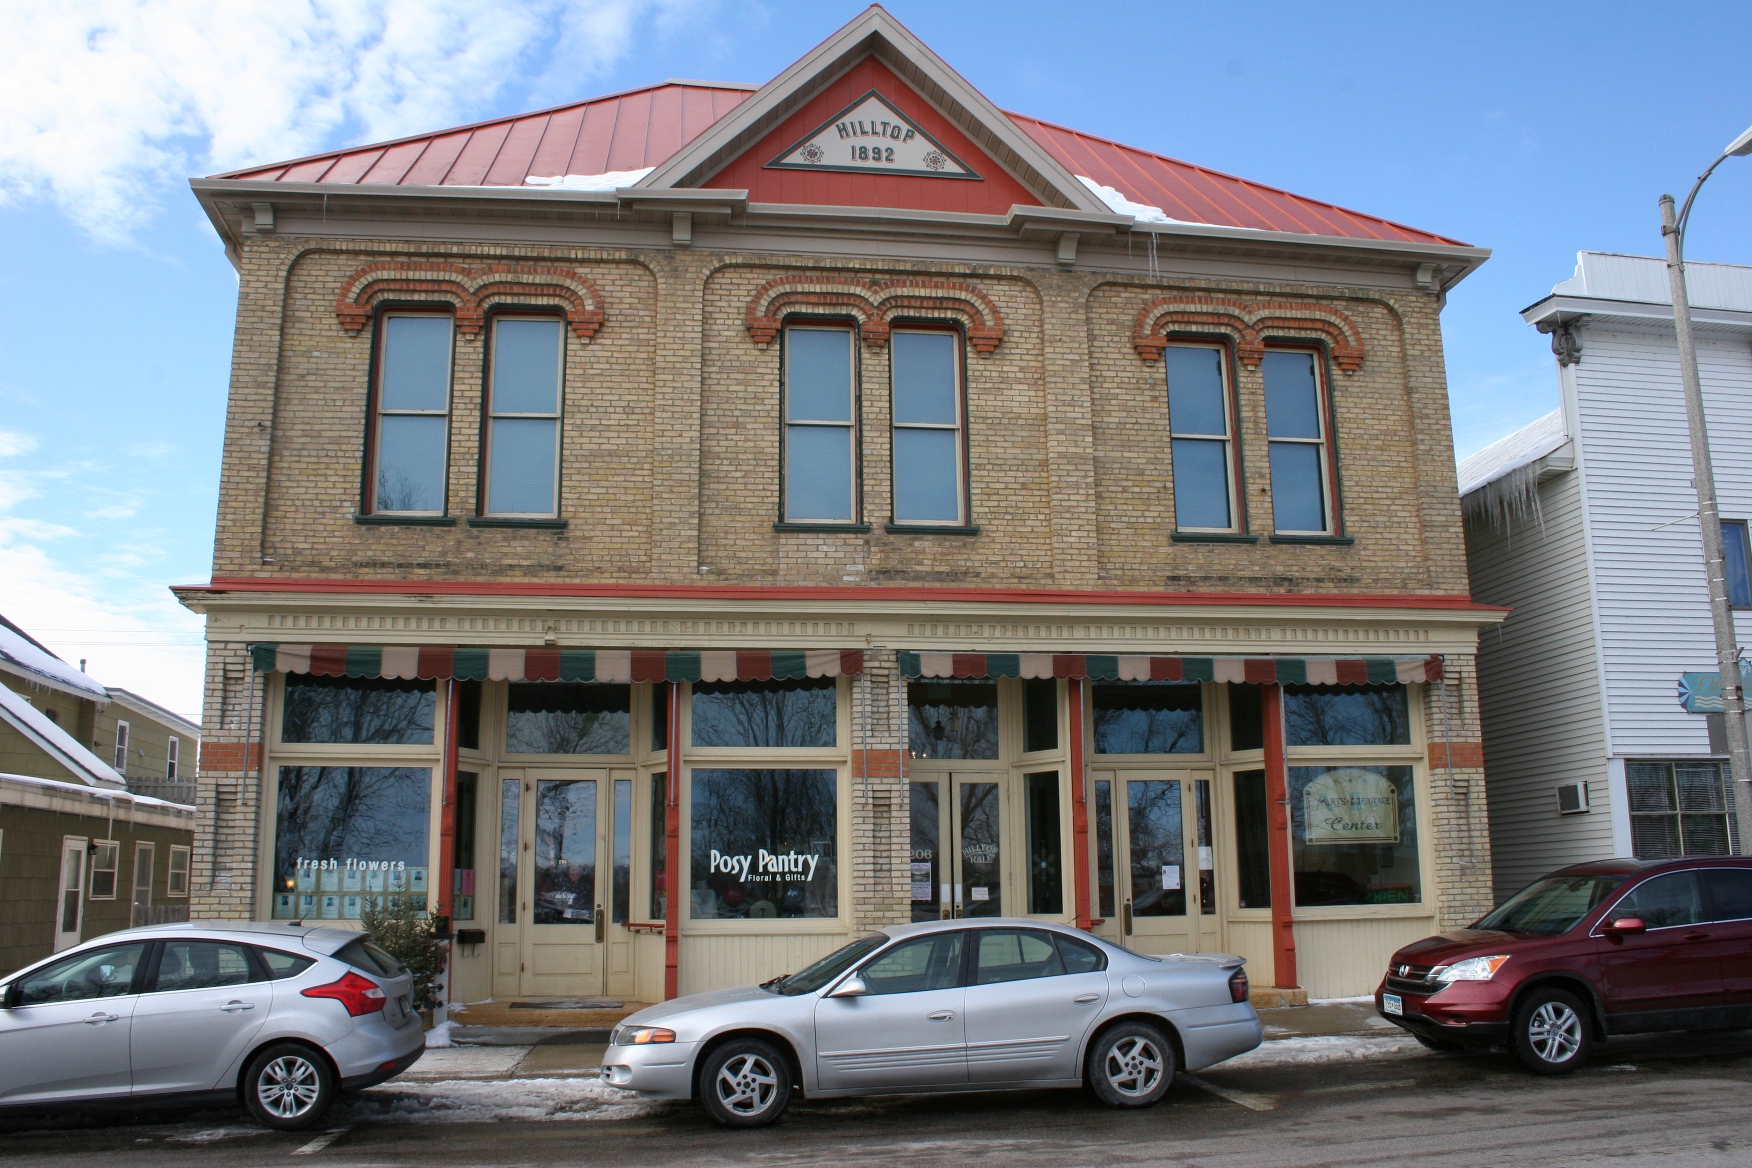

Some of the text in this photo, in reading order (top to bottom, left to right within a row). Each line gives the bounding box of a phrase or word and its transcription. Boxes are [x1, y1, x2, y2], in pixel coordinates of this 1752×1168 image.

[835, 120, 917, 144] HILLTOP
[850, 145, 896, 164] 1892
[1325, 817, 1381, 831] Center
[910, 849, 932, 860] 206
[962, 844, 998, 857] HILLTOP
[296, 856, 405, 871] fresh flowers
[710, 849, 819, 883] Posy Pantry
[970, 856, 993, 864] HALL
[748, 873, 806, 882] Floral & Gifts
[1365, 889, 1409, 903] OPEN
